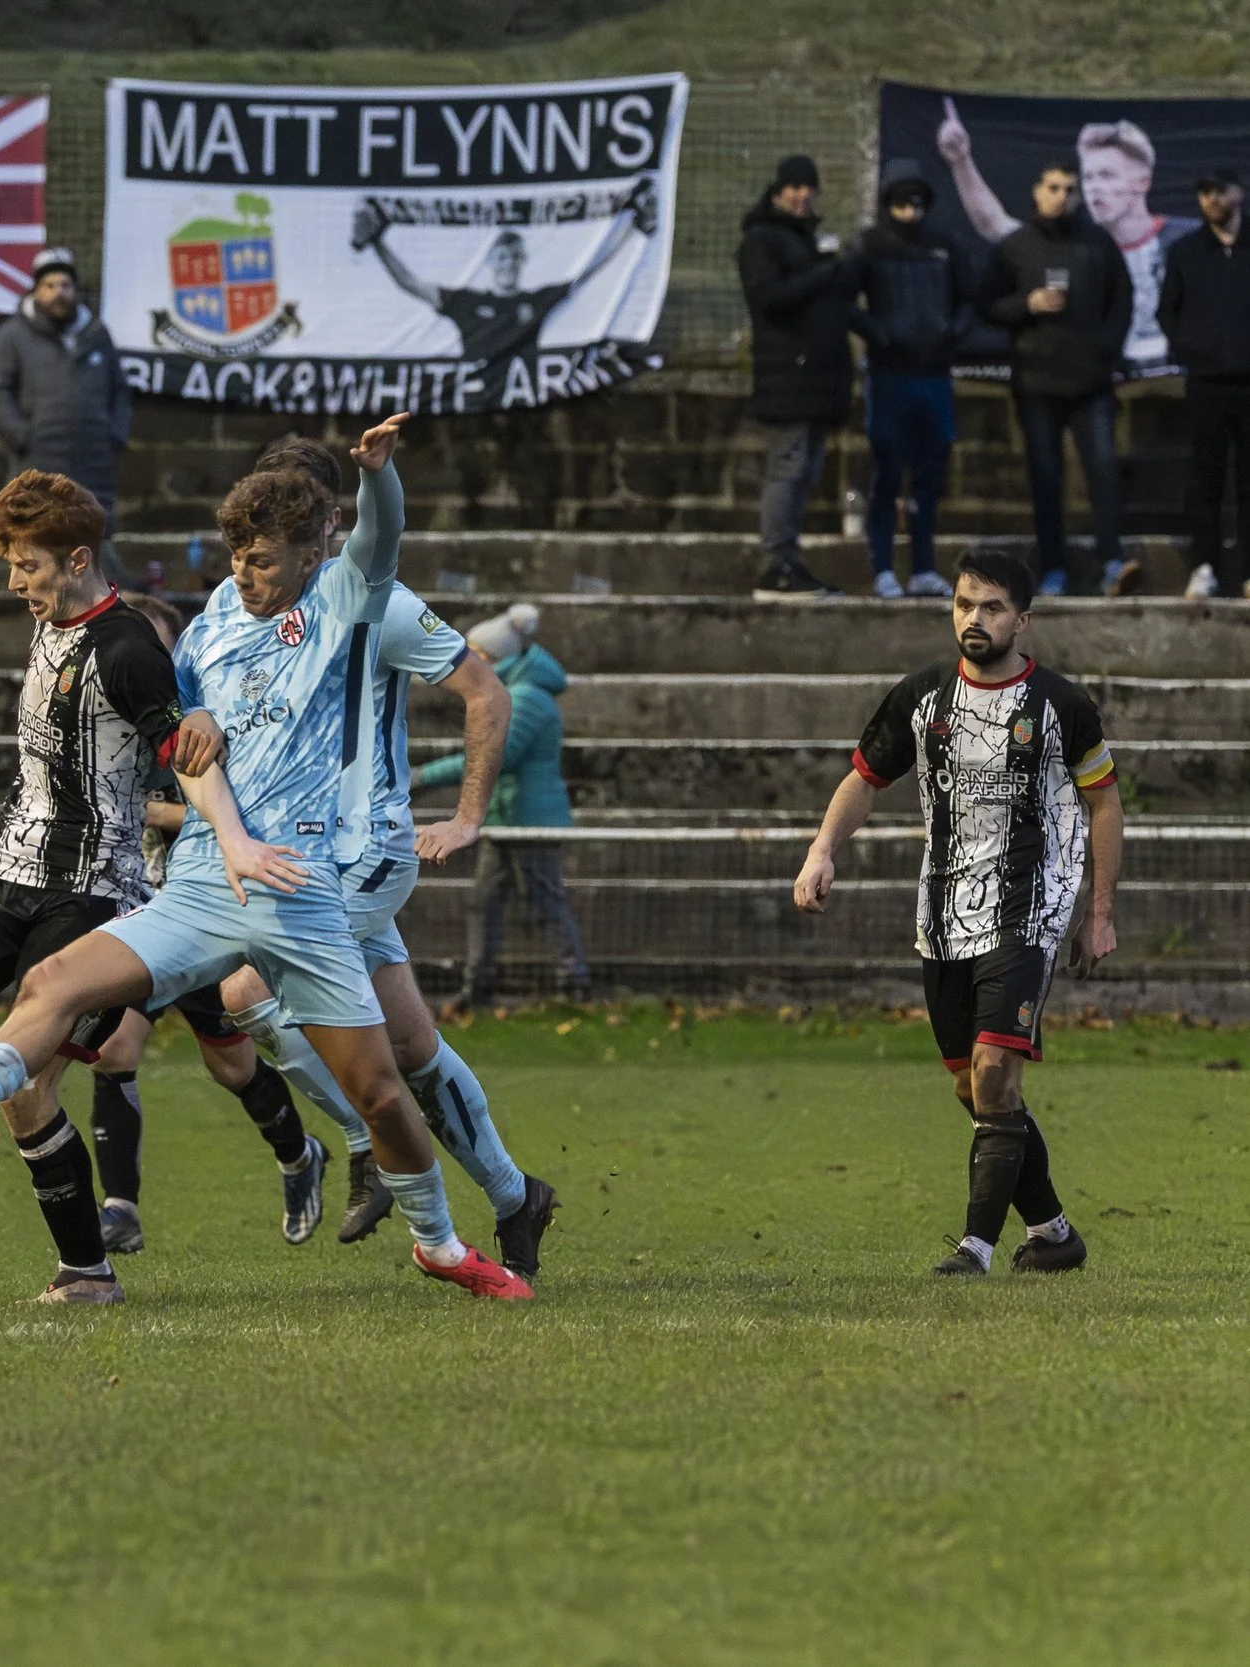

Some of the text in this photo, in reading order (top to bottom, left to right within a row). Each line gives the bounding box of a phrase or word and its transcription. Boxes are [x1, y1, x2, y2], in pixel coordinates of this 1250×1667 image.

[140, 96, 652, 177] MATT FLYNN'S
[956, 768, 1029, 784] ANORD
[956, 782, 1029, 795] MARDIX
